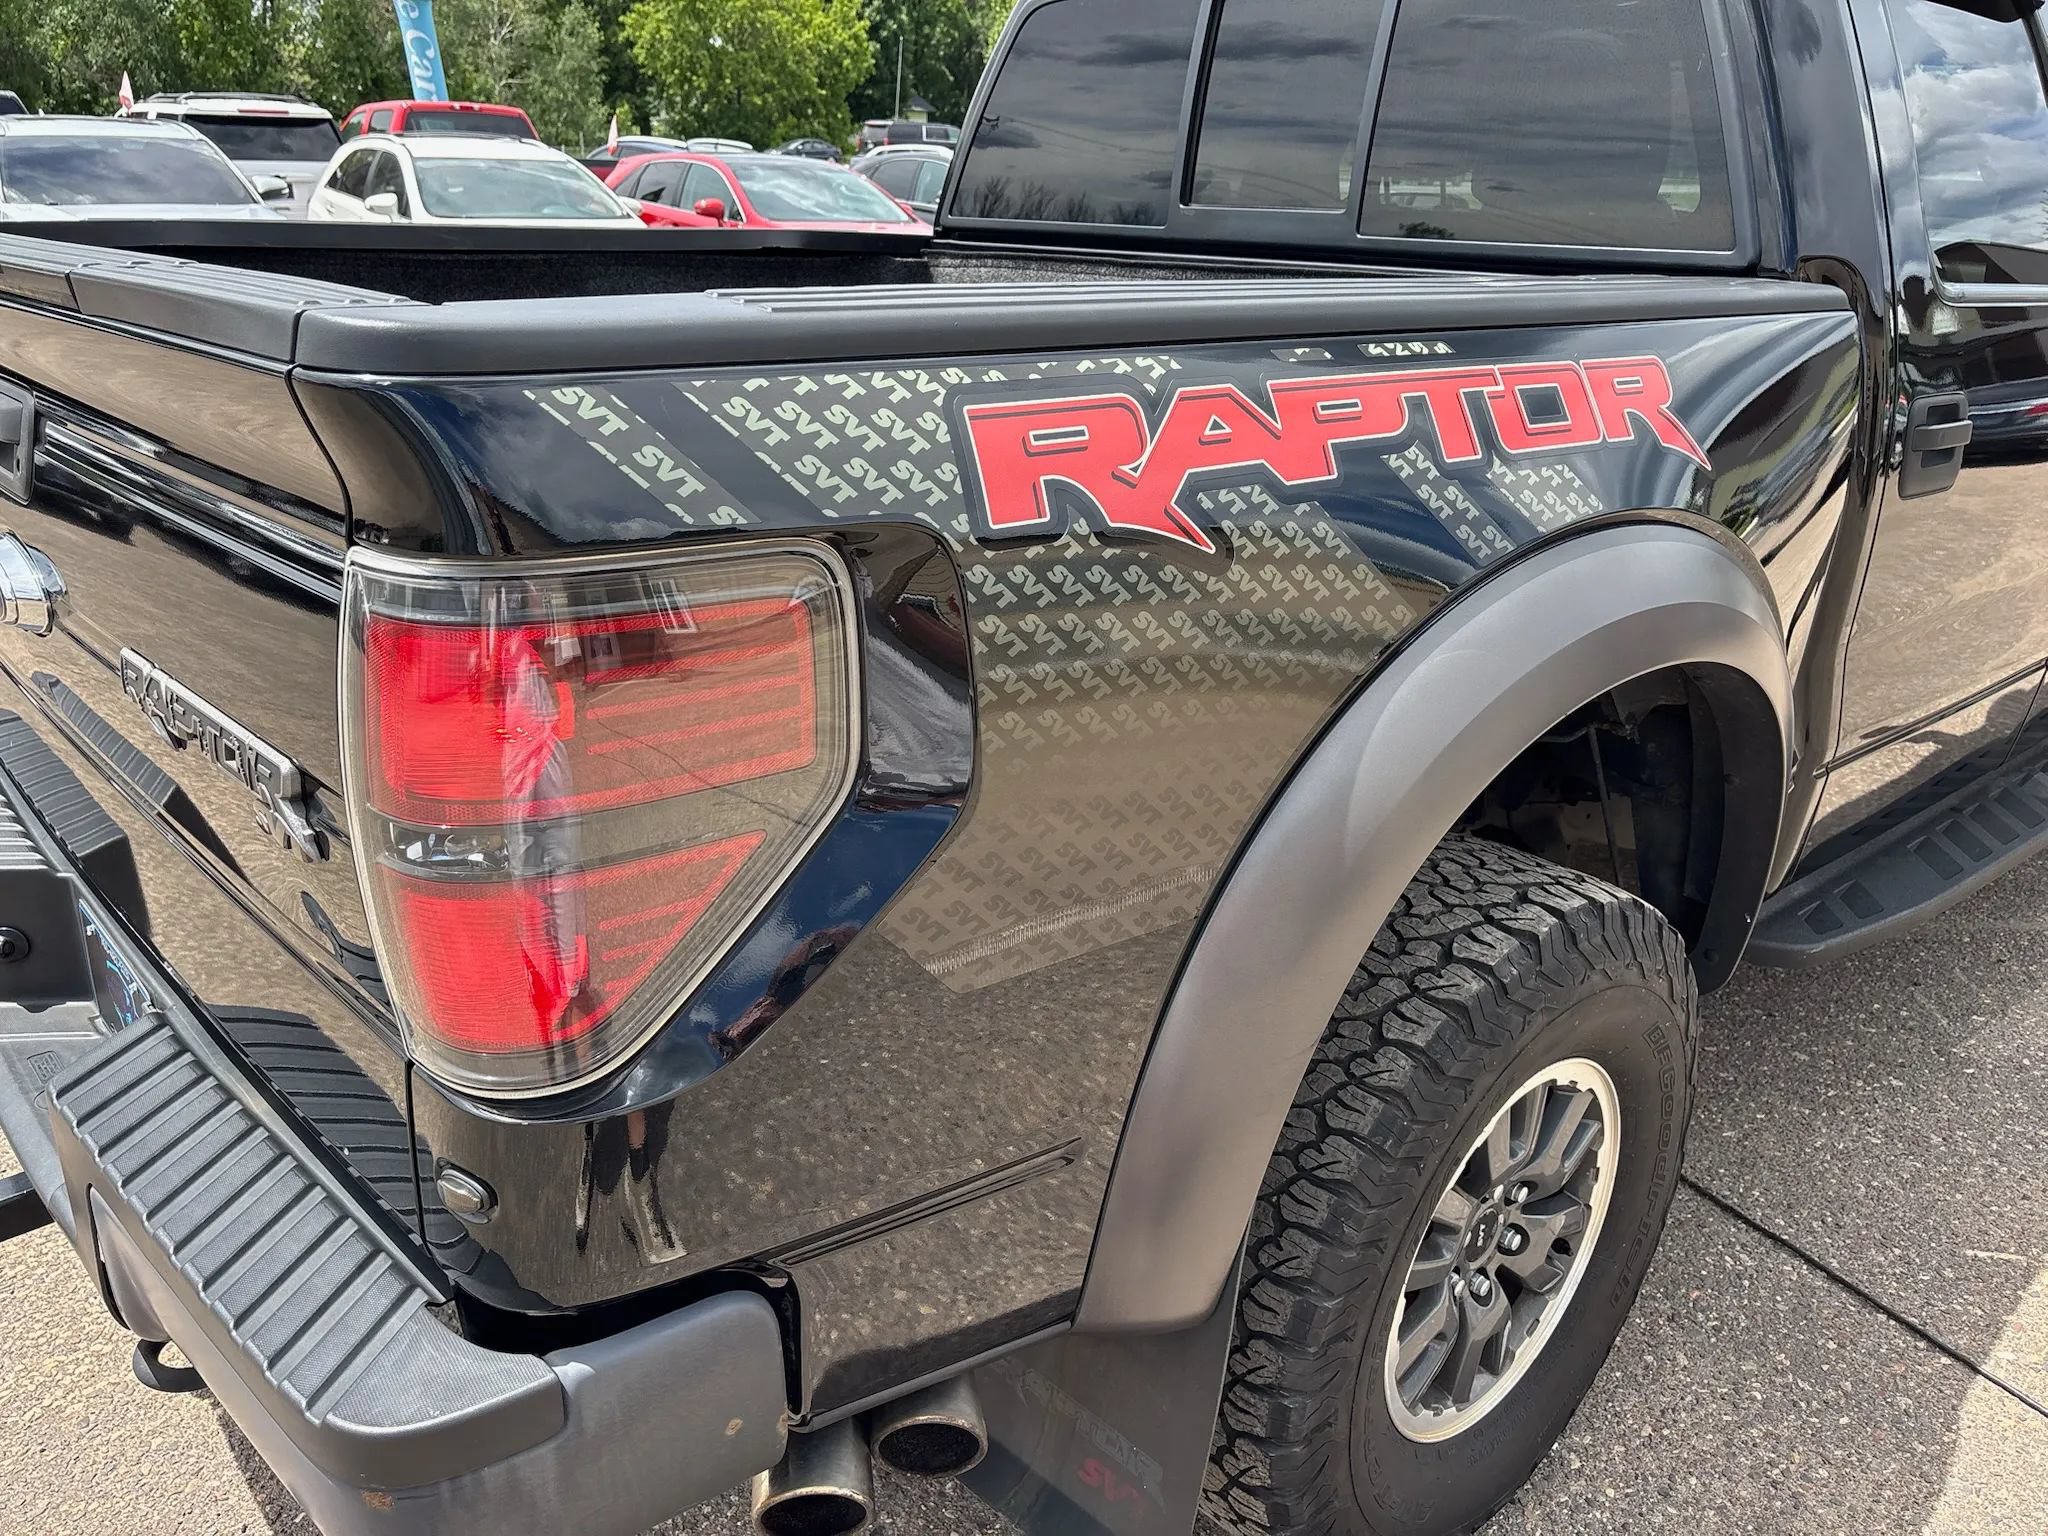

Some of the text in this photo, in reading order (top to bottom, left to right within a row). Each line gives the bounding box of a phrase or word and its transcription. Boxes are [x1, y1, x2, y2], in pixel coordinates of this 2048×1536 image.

[871, 371, 912, 404] VT
[551, 387, 629, 436] SVT
[721, 396, 791, 447] SVT
[773, 400, 839, 449] SVT
[823, 404, 887, 452] SVT
[916, 411, 951, 443] SV
[870, 408, 931, 455] SVT
[632, 444, 706, 499] SVT
[964, 355, 1711, 552] RAPTOR
[1388, 454, 1413, 479] VT
[1404, 447, 1440, 480] SVT
[794, 454, 858, 503] SVT
[842, 457, 905, 505] SVT
[889, 460, 949, 507] SVT
[1218, 489, 1247, 515] VT
[1417, 484, 1454, 519] SVT
[1444, 486, 1479, 520] SVT
[1520, 489, 1553, 521] SVT
[1544, 490, 1574, 521] SVT
[1249, 520, 1290, 559] SVT
[1281, 521, 1321, 559] SVT
[1312, 521, 1351, 559] SVT
[1456, 524, 1492, 559] SVT
[965, 564, 1018, 608] SVT
[1006, 564, 1058, 608] SVT
[1046, 565, 1096, 607] SVT
[1085, 565, 1132, 606] SVT
[1122, 565, 1168, 606] SVT
[1160, 564, 1202, 605] SVT
[1227, 564, 1267, 604] SVT
[1259, 564, 1300, 602] SVT
[1291, 564, 1330, 601] SVT
[1322, 564, 1360, 601] SVT
[1352, 564, 1391, 601] SVT
[977, 614, 1028, 657] SVT
[1018, 614, 1067, 656] SVT
[1058, 613, 1104, 654] SVT
[1096, 612, 1141, 652] SVT
[1132, 611, 1176, 651] SVT
[1168, 610, 1210, 649] SVT
[1202, 610, 1243, 648] SVT
[1235, 608, 1275, 646] SVT
[1267, 608, 1306, 644] SVT
[1299, 607, 1339, 643] SVT
[1330, 606, 1368, 641] SVT
[1361, 605, 1398, 640] SVT
[988, 663, 1037, 704] SVT
[1028, 662, 1076, 702] SVT
[1067, 660, 1112, 700] SVT
[1104, 659, 1148, 698] SVT
[1140, 656, 1182, 696] SVT
[1176, 655, 1216, 692] SVT
[1209, 654, 1248, 690] SVT
[1243, 652, 1281, 689] SVT
[998, 711, 1045, 751] SVT
[1038, 709, 1083, 748] SVT
[1076, 706, 1120, 743] SVT
[120, 647, 330, 862] RAPTOR
[1051, 799, 1093, 835] SVT
[1087, 795, 1129, 830] SVT
[1124, 791, 1163, 826] SVT
[1158, 787, 1197, 821] SVT
[1192, 784, 1230, 818] SVT
[1090, 836, 1133, 871] SVT
[1127, 832, 1167, 866] SVT
[1161, 827, 1200, 861] SVT
[1194, 823, 1231, 856] SVT
[937, 857, 985, 893] SVT
[978, 851, 1024, 888] SVT
[1017, 847, 1061, 882] SVT
[1055, 841, 1098, 876] SVT
[942, 900, 990, 935] SVT
[1022, 889, 1060, 914] SV
[901, 907, 951, 942] SVT
